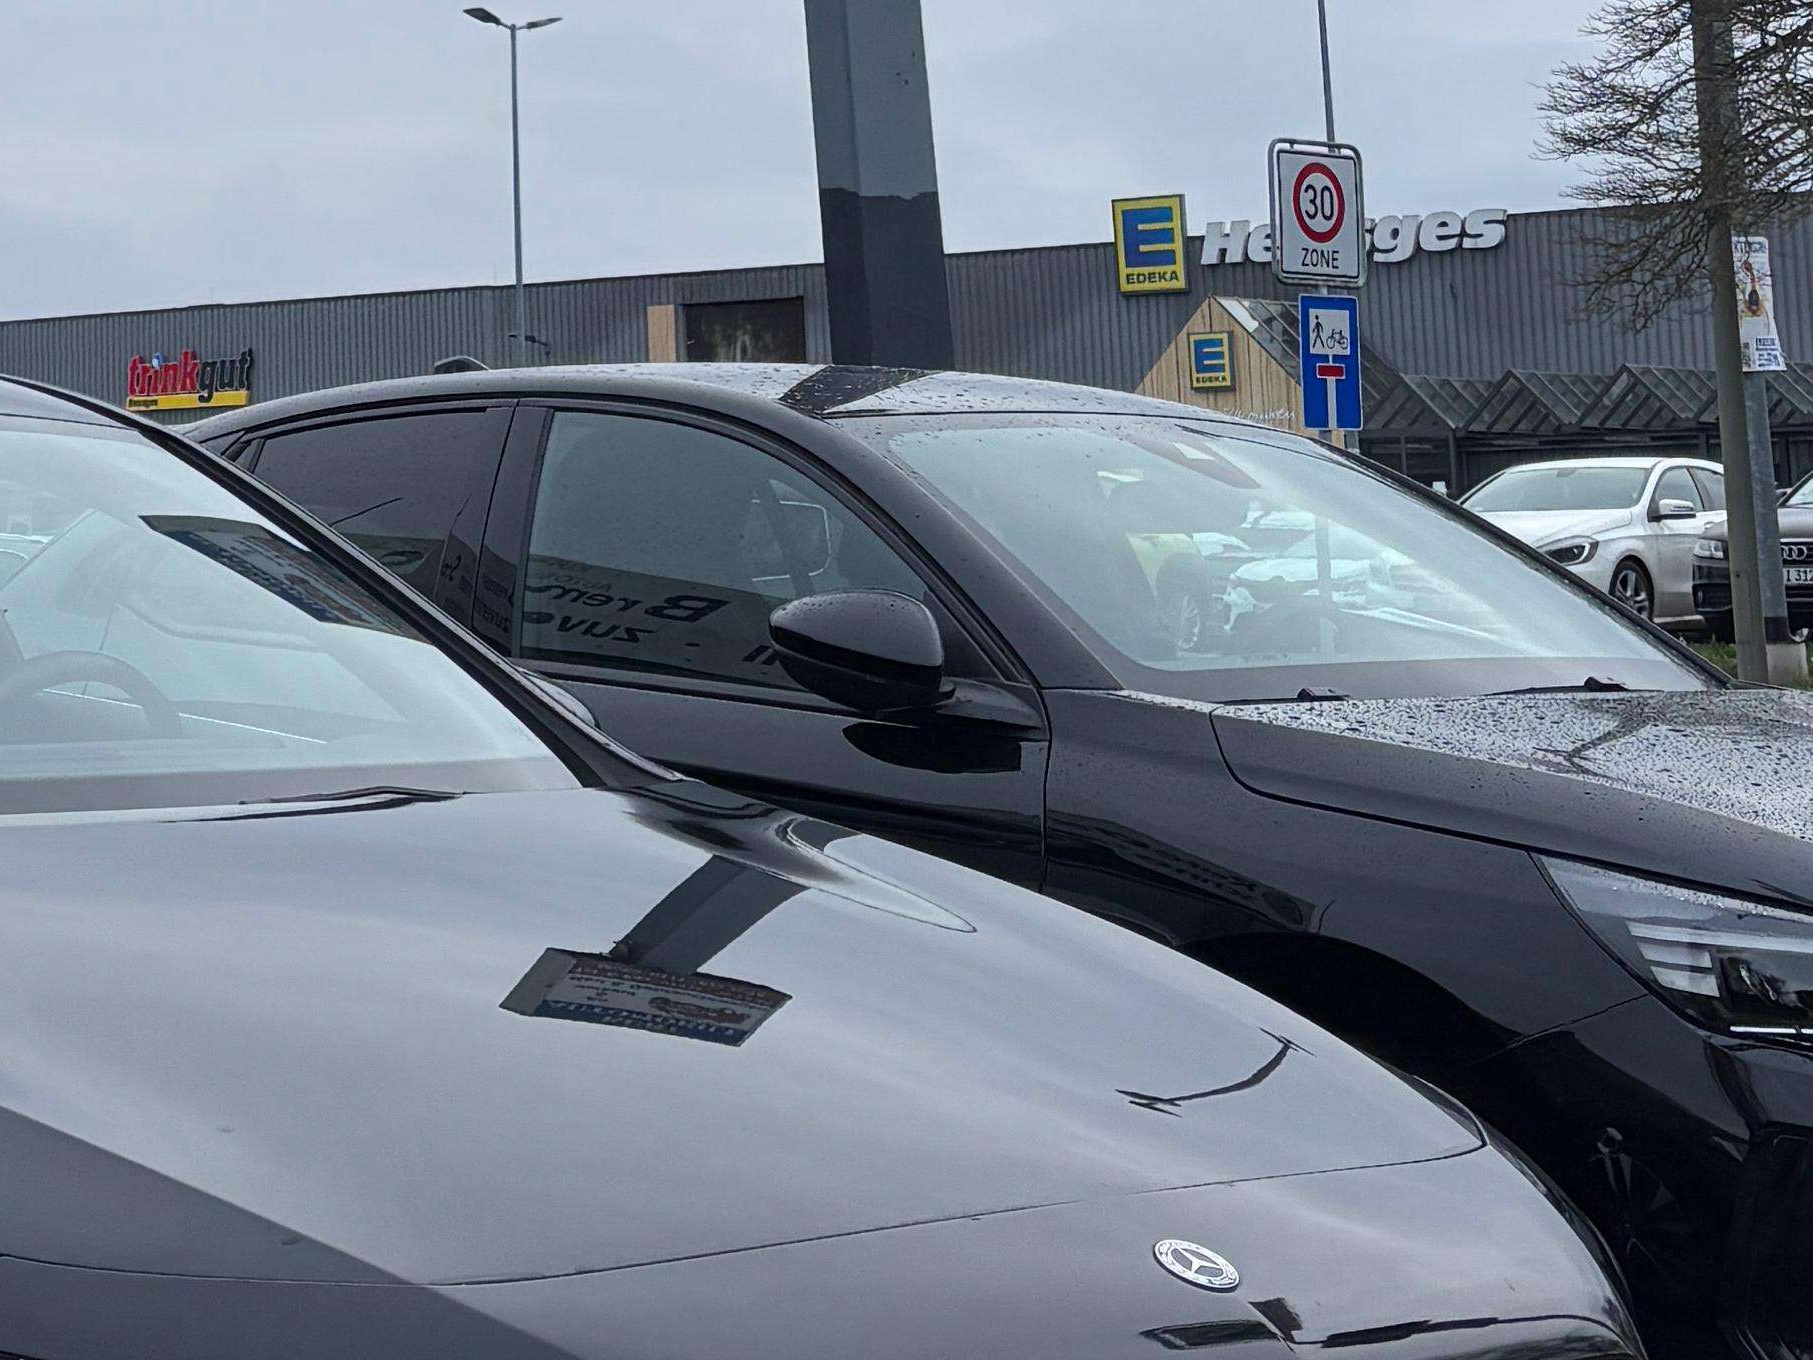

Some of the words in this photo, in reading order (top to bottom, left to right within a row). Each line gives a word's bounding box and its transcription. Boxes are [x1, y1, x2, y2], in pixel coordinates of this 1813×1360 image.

[1303, 184, 1334, 221] 30
[1301, 248, 1340, 270] ZONE
[1126, 271, 1180, 285] EDEKA
[128, 348, 254, 404] trinkgut
[1195, 374, 1228, 385] EDEKA
